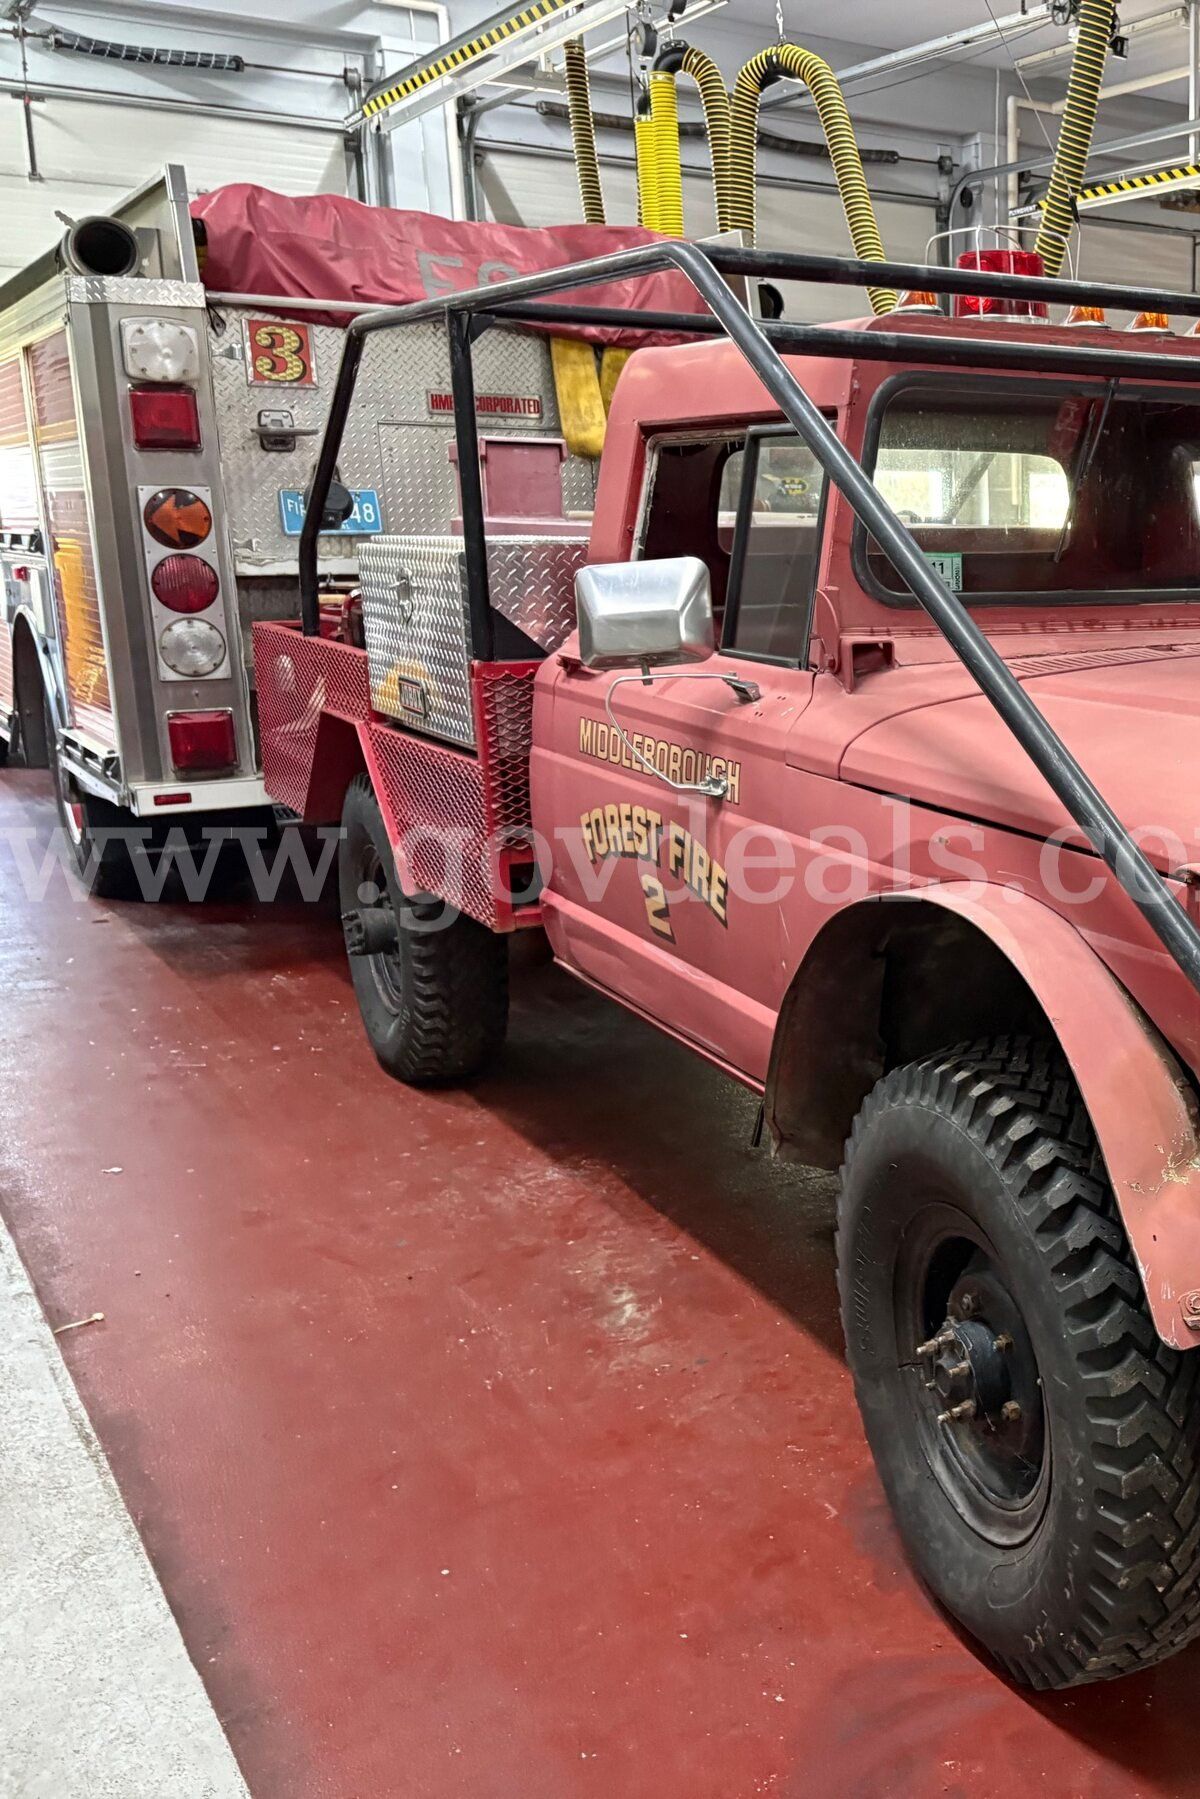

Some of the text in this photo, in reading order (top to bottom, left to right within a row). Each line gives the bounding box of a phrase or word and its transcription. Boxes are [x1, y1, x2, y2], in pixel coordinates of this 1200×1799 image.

[255, 325, 307, 382] 3
[580, 803, 728, 929] FOREST FIRE
[641, 873, 676, 945] 2
